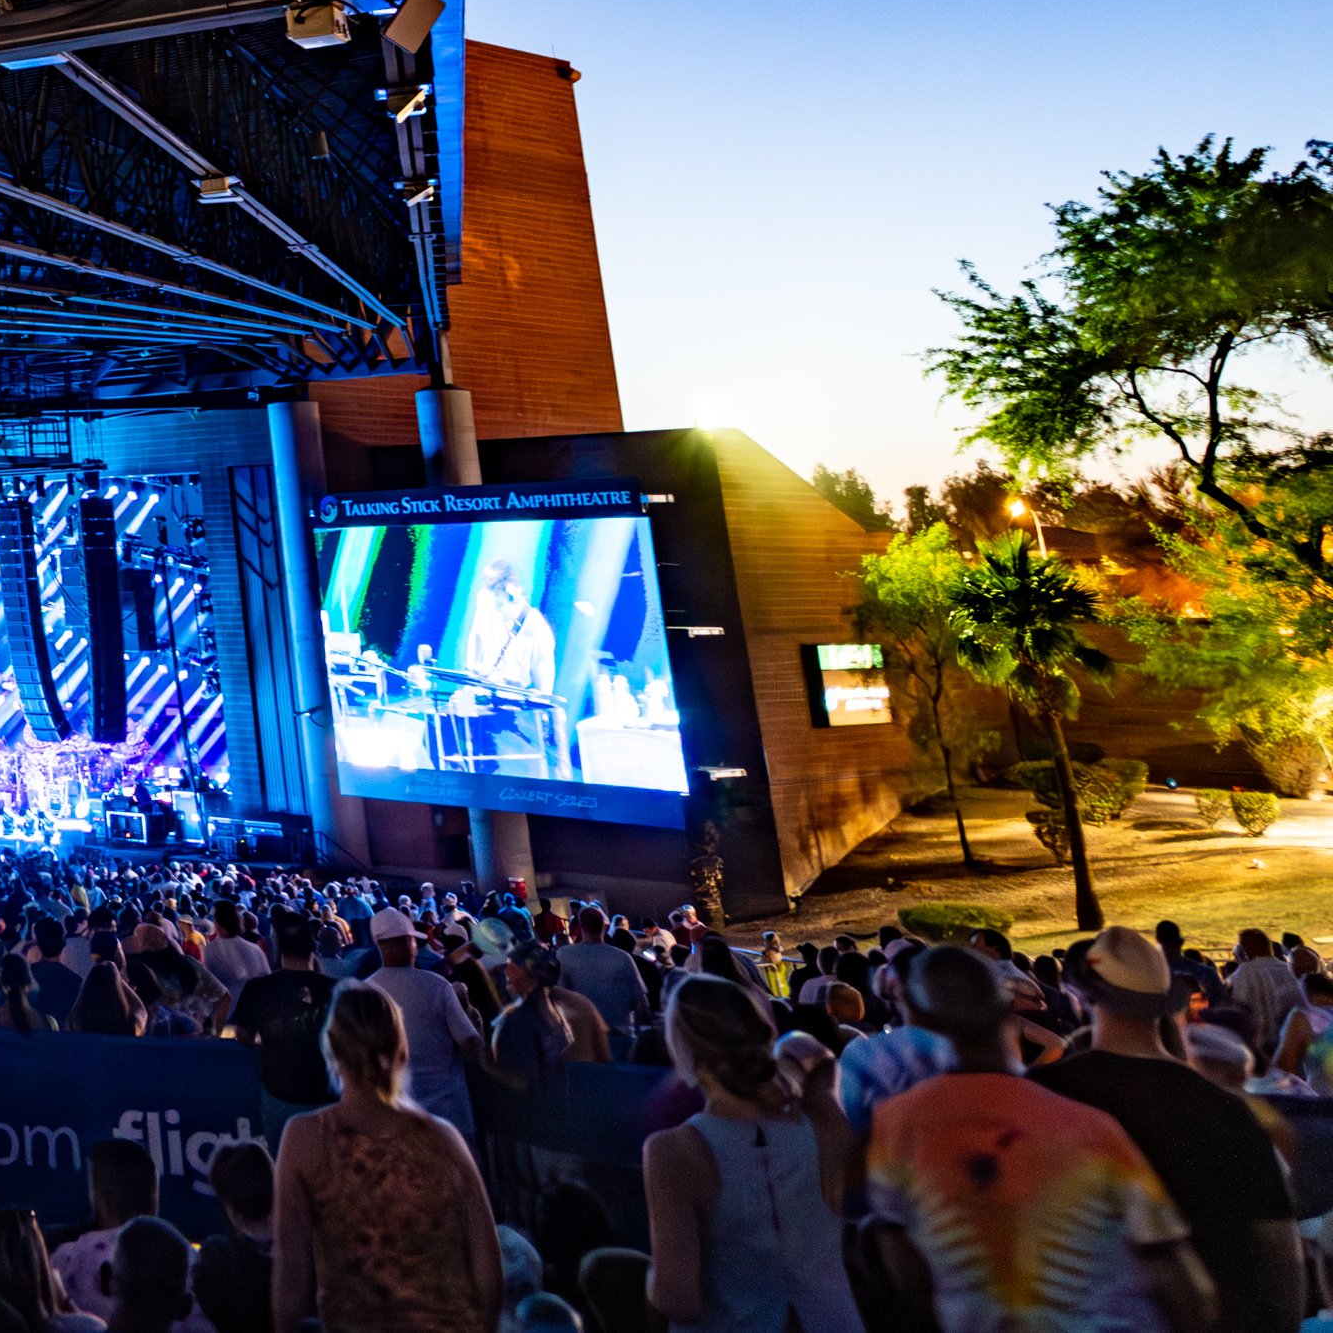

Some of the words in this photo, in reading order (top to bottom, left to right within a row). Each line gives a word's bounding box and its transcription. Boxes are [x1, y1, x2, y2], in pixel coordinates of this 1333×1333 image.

[340, 498, 400, 518] TALKING
[402, 496, 442, 514] STICK
[443, 492, 502, 513] RESORT
[506, 489, 632, 511] AMPHITHEATRE
[499, 787, 552, 805] CONCERT
